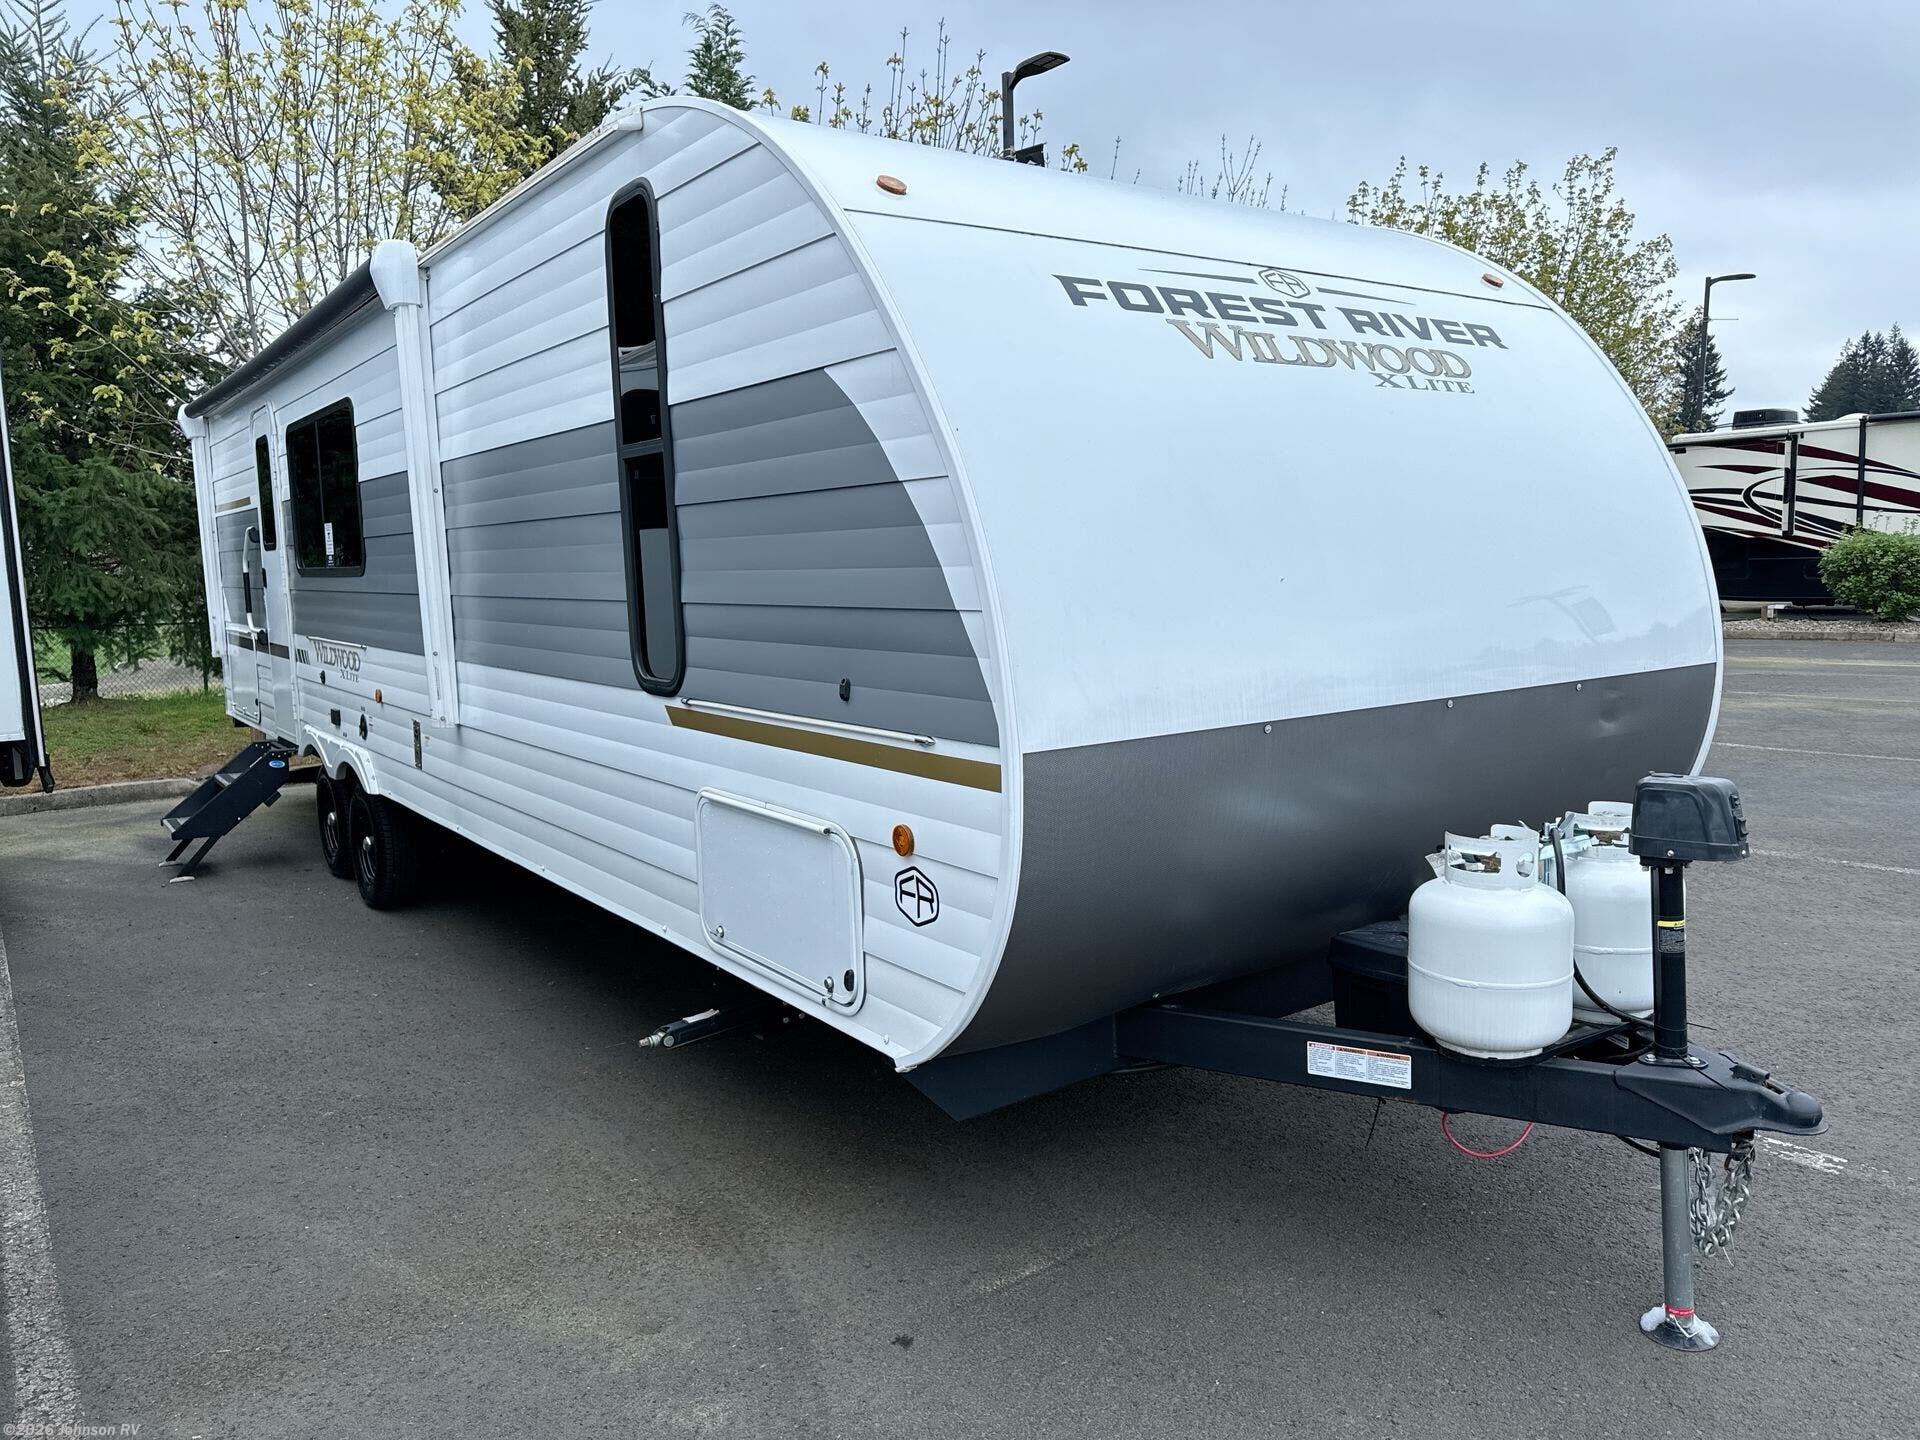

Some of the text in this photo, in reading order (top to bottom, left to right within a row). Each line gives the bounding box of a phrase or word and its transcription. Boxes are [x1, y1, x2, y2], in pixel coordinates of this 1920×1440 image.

[1051, 273, 1510, 350] FOREST RIVER
[1166, 318, 1472, 379] WILDWOOD
[313, 640, 361, 672] WILDWOOD
